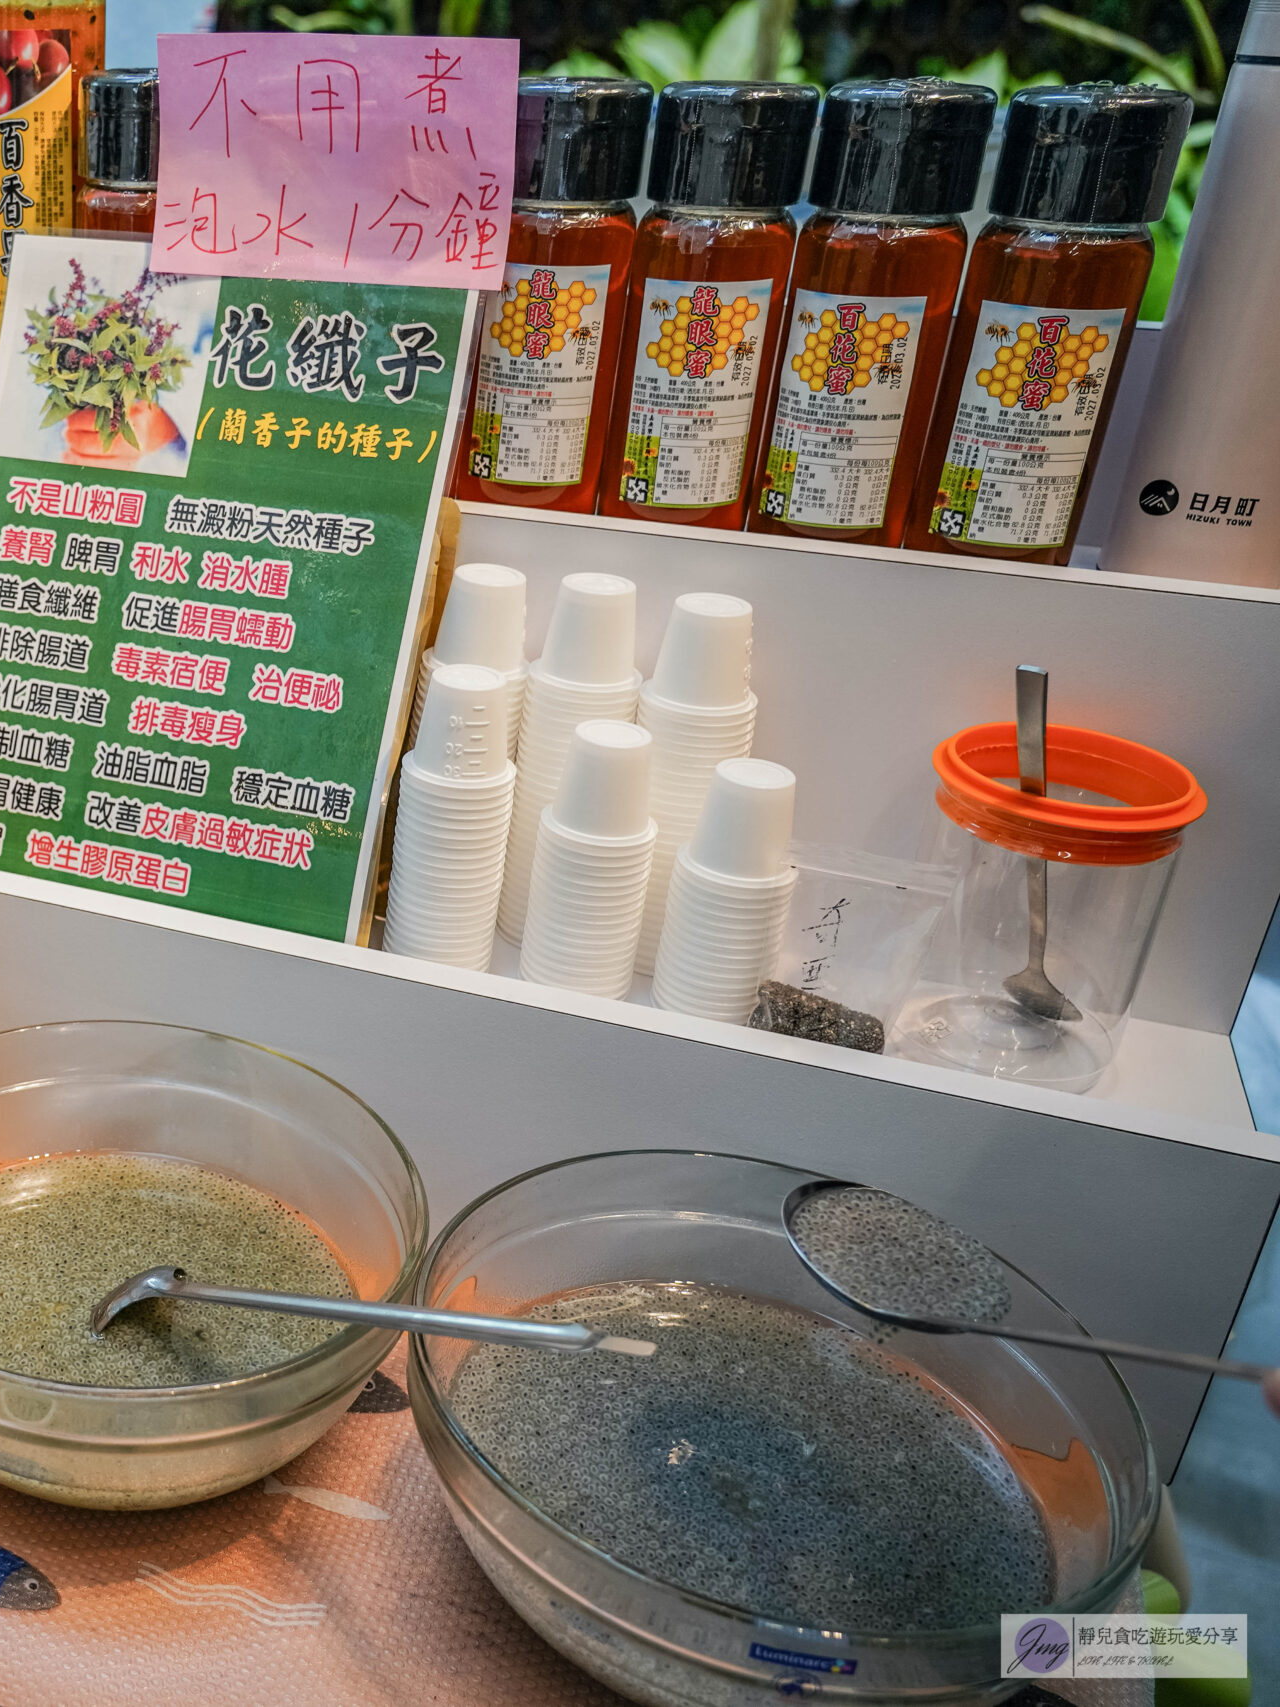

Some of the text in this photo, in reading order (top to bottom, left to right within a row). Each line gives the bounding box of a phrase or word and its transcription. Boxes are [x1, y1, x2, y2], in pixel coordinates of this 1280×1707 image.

[189, 48, 476, 160] 不用煮
[524, 269, 557, 359] 龍眼蜜
[684, 286, 721, 380] 龍眼蜜
[824, 303, 866, 395] 百花蜜
[210, 304, 444, 402] 花纖子
[1019, 315, 1070, 412] 百花蜜
[8, 479, 374, 554] 不是山粉圓 無澱粉天然種子
[1186, 513, 1252, 527] HIZUKI TOWN
[1189, 492, 1260, 517] 日月町
[1, 529, 290, 597] 養腎 脾胃 利水 消水腫
[123, 596, 294, 651] 促進腸胃蠕動
[113, 645, 227, 693] 毒素宿便
[132, 700, 245, 748] 排毒瘦身
[94, 743, 208, 794] 油脂血脂
[232, 769, 353, 822] 穩定血糖
[27, 833, 190, 895] 增生膠原蛋白
[87, 793, 313, 870] 改善皮膚過敏症狀
